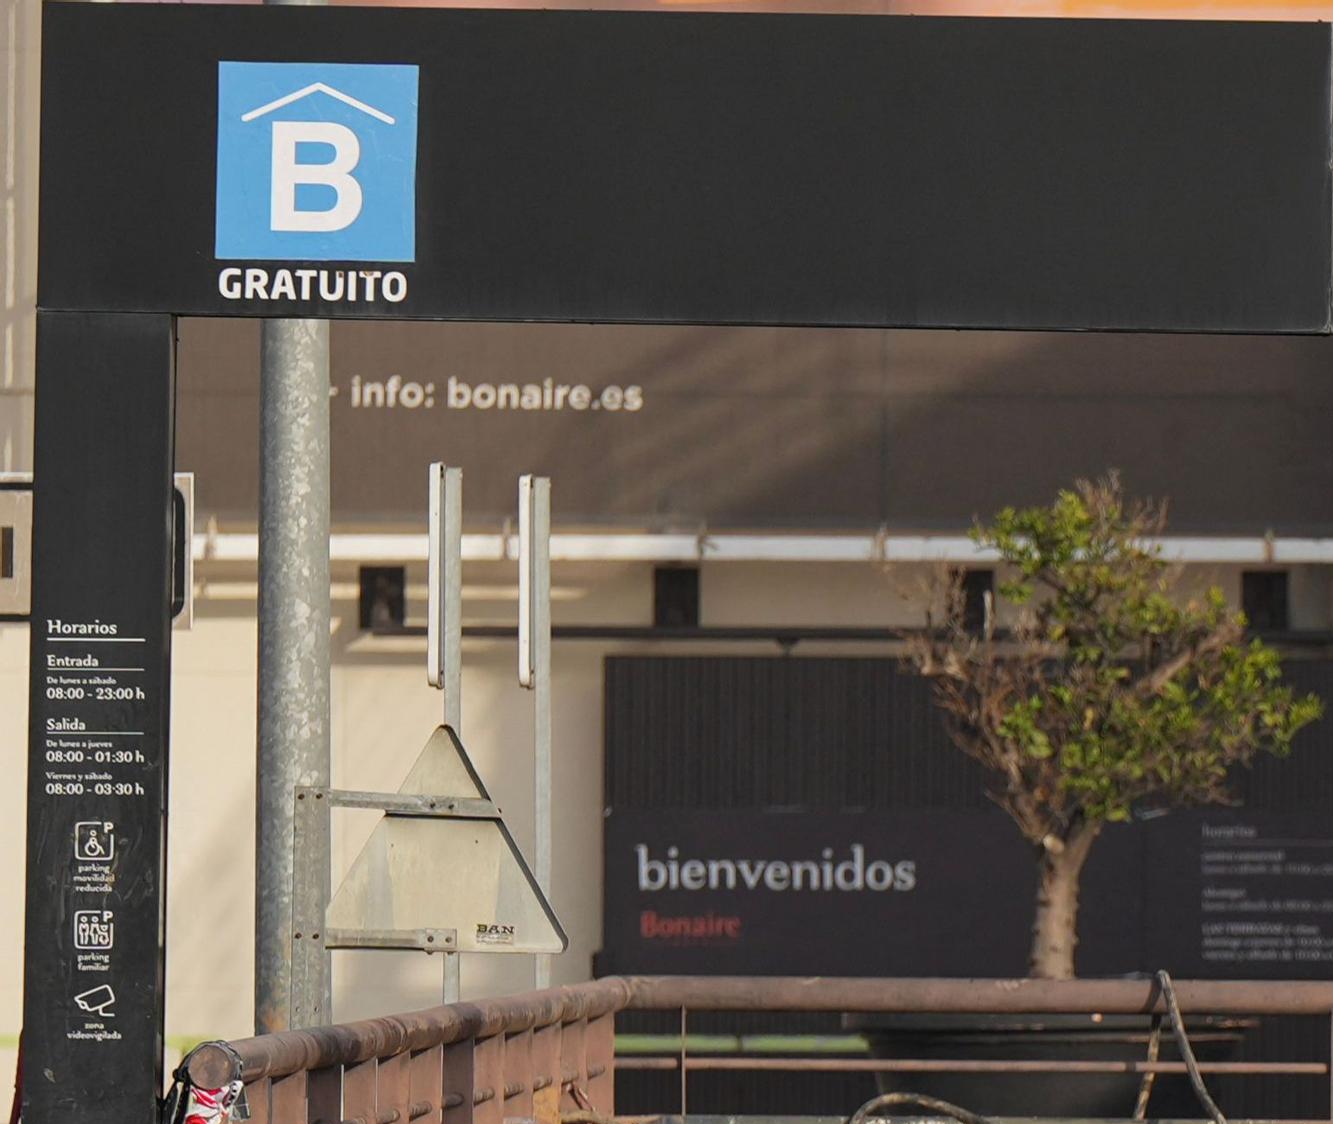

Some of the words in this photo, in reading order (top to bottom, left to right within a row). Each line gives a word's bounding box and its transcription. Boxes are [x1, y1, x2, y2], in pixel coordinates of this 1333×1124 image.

[271, 122, 362, 232] B
[218, 267, 407, 302] GRATUITO
[351, 375, 434, 408] info:
[447, 376, 643, 411] bonaire.es
[47, 620, 117, 635] Horarios
[47, 655, 99, 667] Entrada
[46, 676, 58, 684] De
[46, 687, 85, 700] 08:00
[95, 687, 134, 700] 23:00
[135, 686, 145, 700] h
[46, 718, 86, 731] Salida
[46, 739, 58, 748] De
[45, 750, 84, 763] 08:00
[94, 750, 133, 763] 01:30
[135, 749, 145, 763] h
[45, 783, 84, 795] 08:00
[94, 783, 133, 795] 03:30
[135, 782, 145, 795] h
[78, 864, 110, 874] parking
[637, 844, 915, 893] bienvenidos
[73, 873, 115, 882] movilidad
[75, 883, 112, 892] reducida
[641, 912, 740, 938] Bonaire
[77, 953, 110, 964] parking
[77, 962, 110, 971] familiar
[66, 1030, 122, 1041] videovigilada
